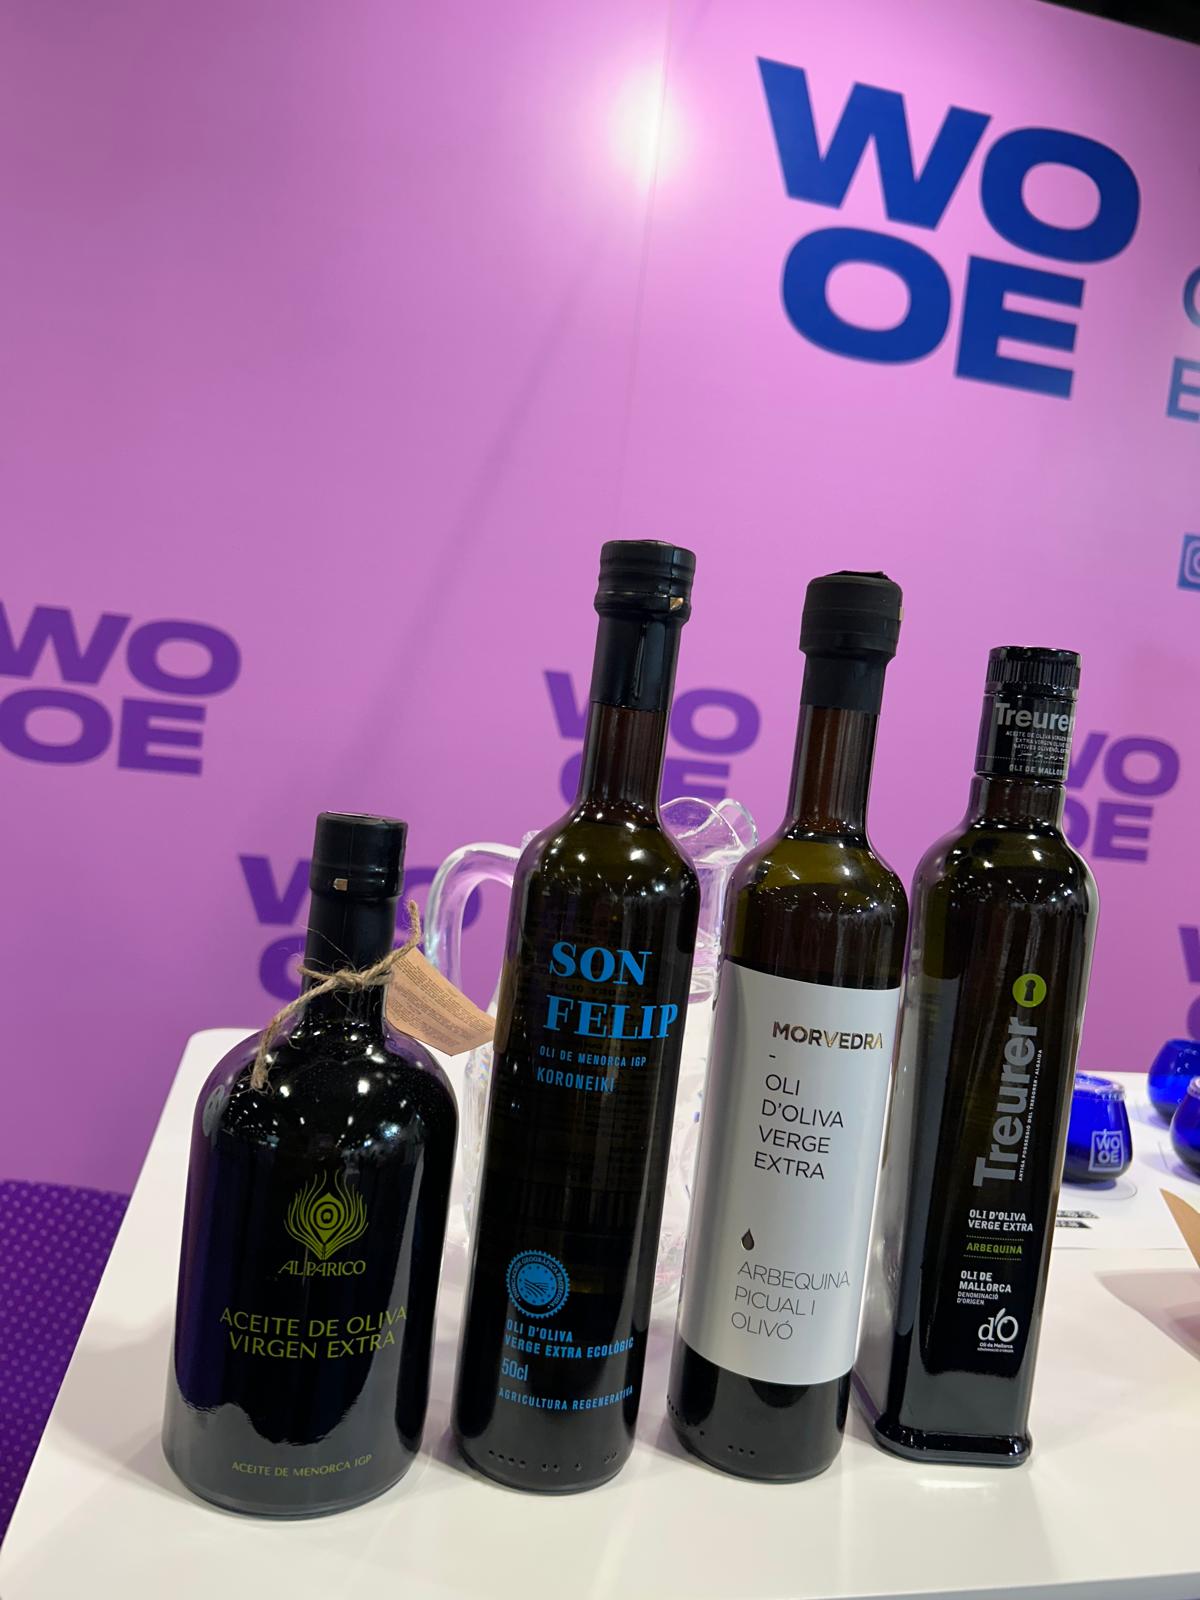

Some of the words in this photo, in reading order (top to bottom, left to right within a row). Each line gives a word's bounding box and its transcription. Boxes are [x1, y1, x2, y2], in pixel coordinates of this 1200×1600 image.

[757, 56, 1141, 265] WO
[780, 227, 1086, 399] OE
[0, 598, 241, 698] WO
[0, 688, 206, 777] OE
[549, 940, 653, 986] SON
[542, 994, 679, 1040] FELIP
[772, 1021, 884, 1050] MORVEDRA
[540, 1045, 555, 1058] OLI
[560, 1050, 573, 1062] DE
[578, 1052, 627, 1067] MENORCA
[631, 1055, 647, 1067] IGP
[537, 1066, 616, 1093] KORONEIKI
[765, 1073, 800, 1096] OLI
[761, 1098, 844, 1128] D'OLIVA
[972, 1016, 1039, 1187] Treurer
[1026, 1110, 1034, 1123] DEL
[758, 1125, 831, 1154] VERGE
[1096, 1136, 1120, 1150] WO
[754, 1151, 825, 1180] EXTRA
[1097, 1150, 1119, 1164] OE
[968, 1219, 1001, 1231] VERGE
[1003, 1222, 1034, 1232] EXTRA
[969, 1209, 987, 1220] OLI
[988, 1211, 1027, 1222] D'OLIVA
[966, 1242, 1023, 1255] ARBEQUINA
[737, 1261, 850, 1291] ARBEQUINA
[958, 1281, 1012, 1293] MALLORCA
[960, 1270, 977, 1280] OLI
[980, 1271, 993, 1281] DE
[734, 1285, 807, 1316] PICUAL
[957, 1290, 999, 1300] DENOMINACIÓ
[219, 1306, 300, 1337] ACEITE
[308, 1319, 339, 1338] DE
[346, 1305, 408, 1335] OLIVA
[506, 1318, 523, 1334] OLI
[528, 1324, 573, 1343] D'OLIVA
[731, 1311, 793, 1340] OLIVÓ
[229, 1330, 317, 1359] VIRGEN
[327, 1330, 396, 1358] EXTRA
[504, 1334, 541, 1354] VERGE
[545, 1344, 582, 1359] EXTRA
[501, 1357, 528, 1382] 50cl
[498, 1387, 568, 1410] AGRICULTURA
[572, 1385, 633, 1411] REGENERATIVA
[231, 1461, 271, 1476] ACEITE
[274, 1467, 289, 1477] DE
[293, 1461, 351, 1477] MENORCA
[354, 1454, 372, 1468] IGP
